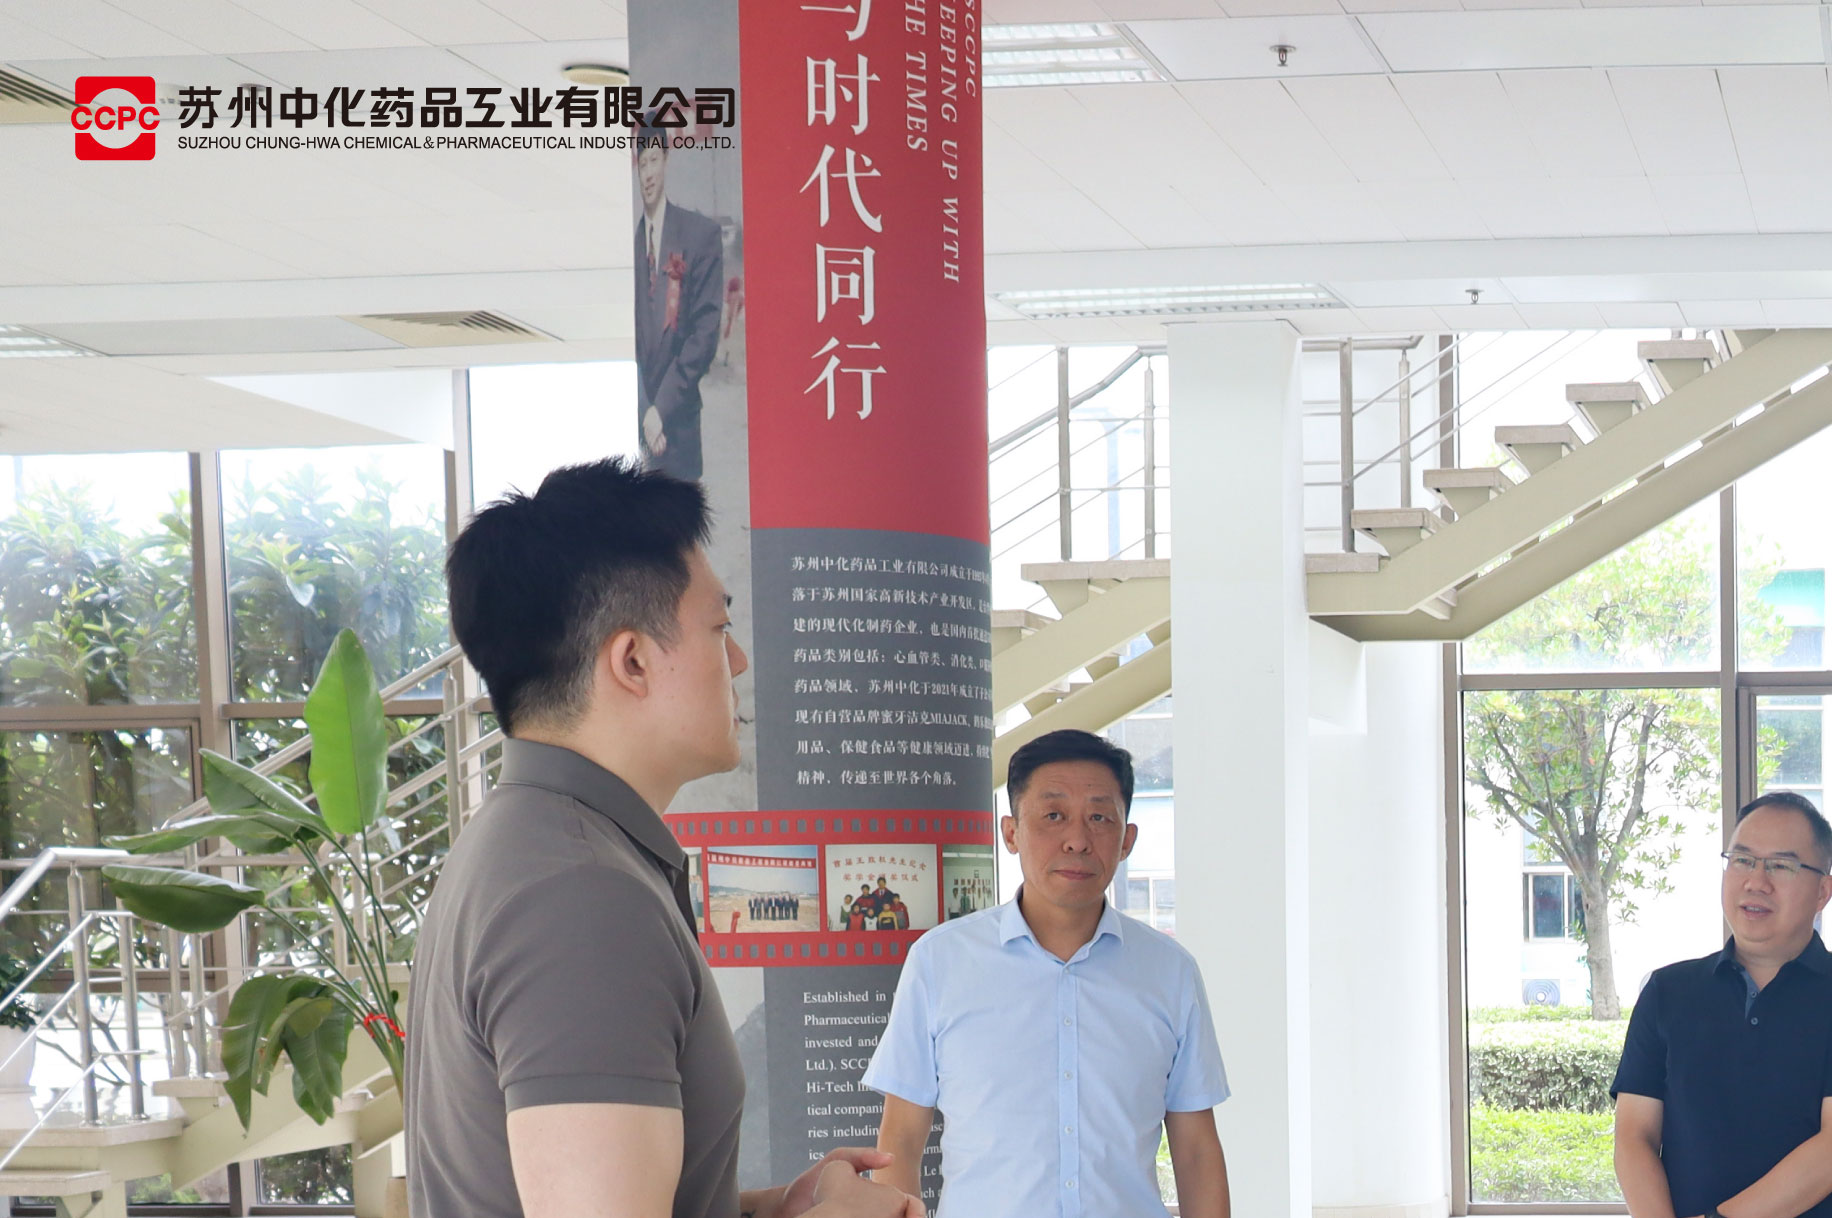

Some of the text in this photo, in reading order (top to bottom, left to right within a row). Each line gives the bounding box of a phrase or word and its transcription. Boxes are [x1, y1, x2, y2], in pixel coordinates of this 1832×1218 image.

[905, 0, 928, 151] HE TIMES
[940, 0, 959, 284] EEPING UP WITH
[803, 991, 869, 1004] Established
[875, 990, 886, 1002] in
[804, 1013, 890, 1026] Pharmaceutical
[804, 1036, 878, 1048] invested and
[806, 1058, 871, 1072] Ltd.). SCC
[806, 1081, 853, 1093] Hi-Tech
[807, 1102, 885, 1117] tical compani
[808, 1125, 879, 1138] ries includin
